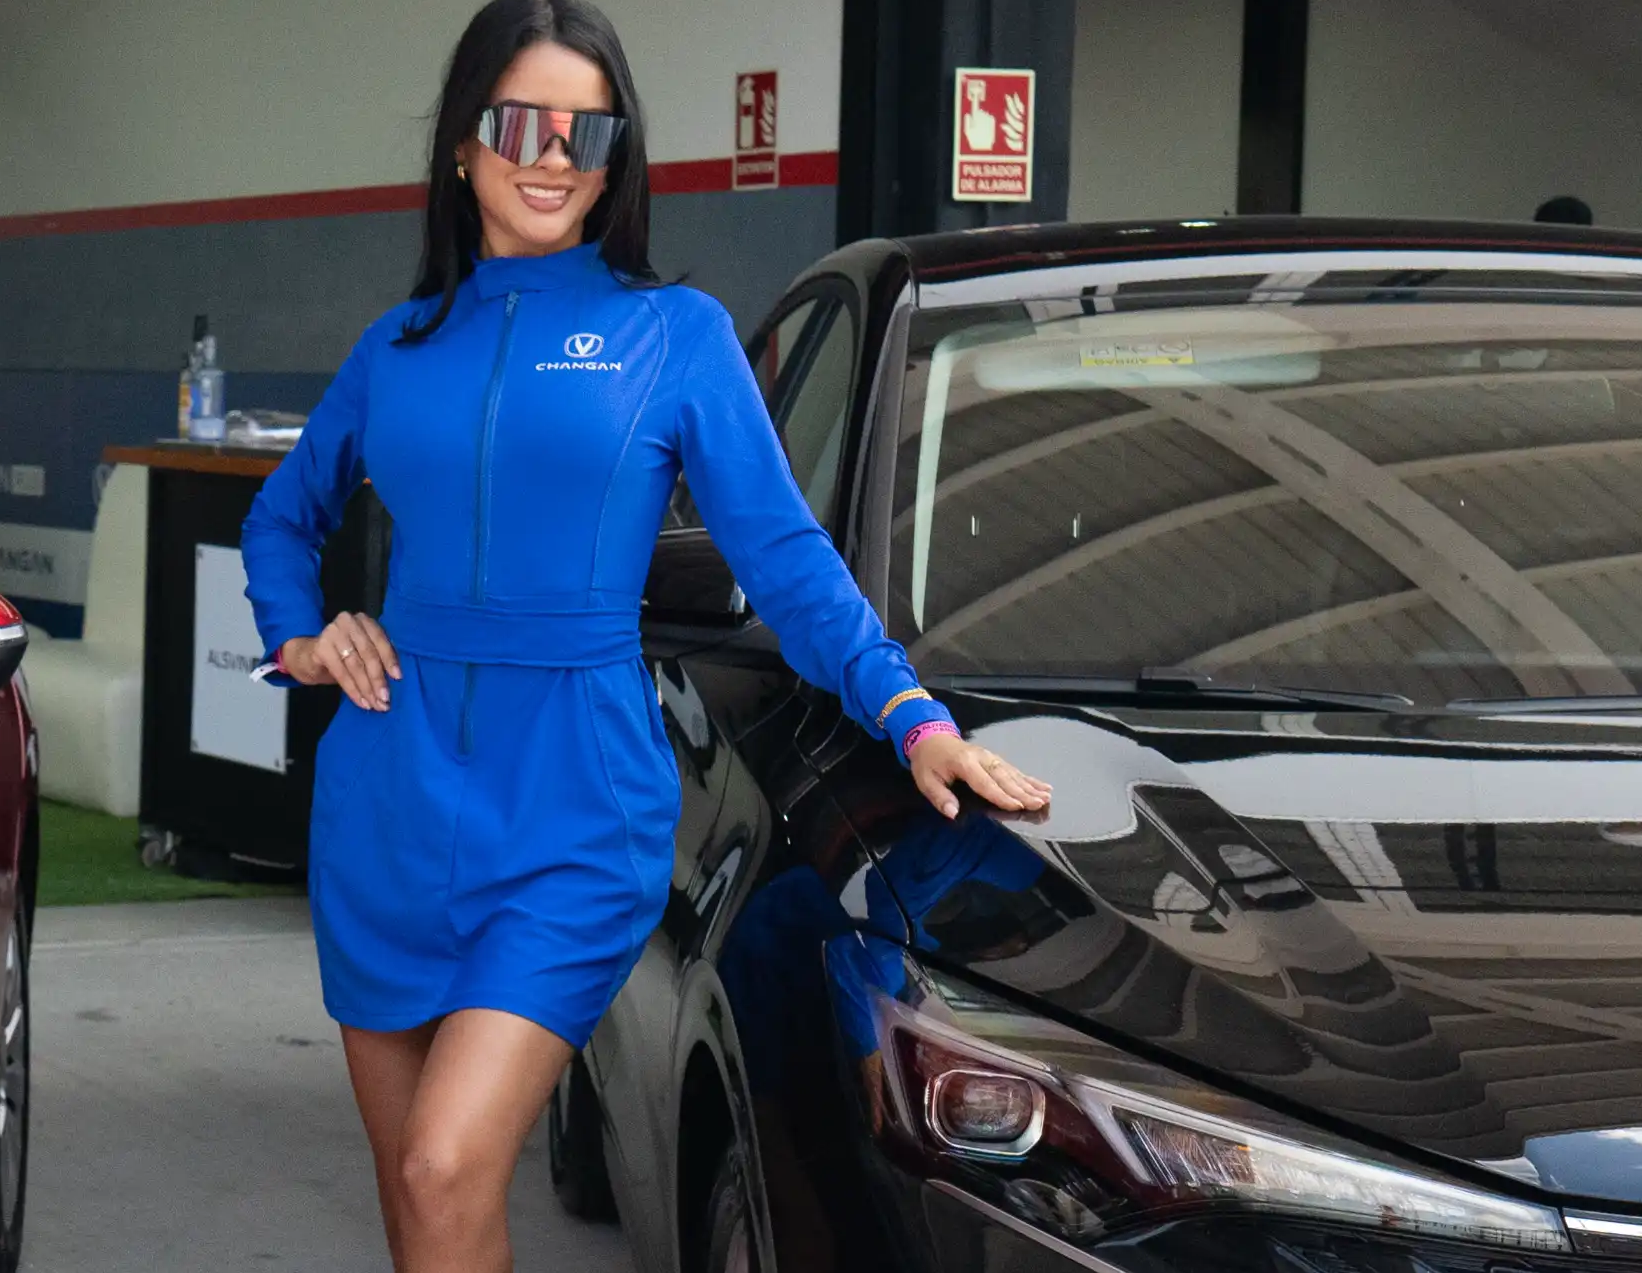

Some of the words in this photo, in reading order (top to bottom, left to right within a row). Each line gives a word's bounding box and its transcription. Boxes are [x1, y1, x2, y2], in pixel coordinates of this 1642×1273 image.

[962, 164, 1022, 178] PULSADOR
[960, 178, 976, 191] DE
[977, 179, 1024, 192] ALARMA
[535, 361, 622, 371] CHANGAN
